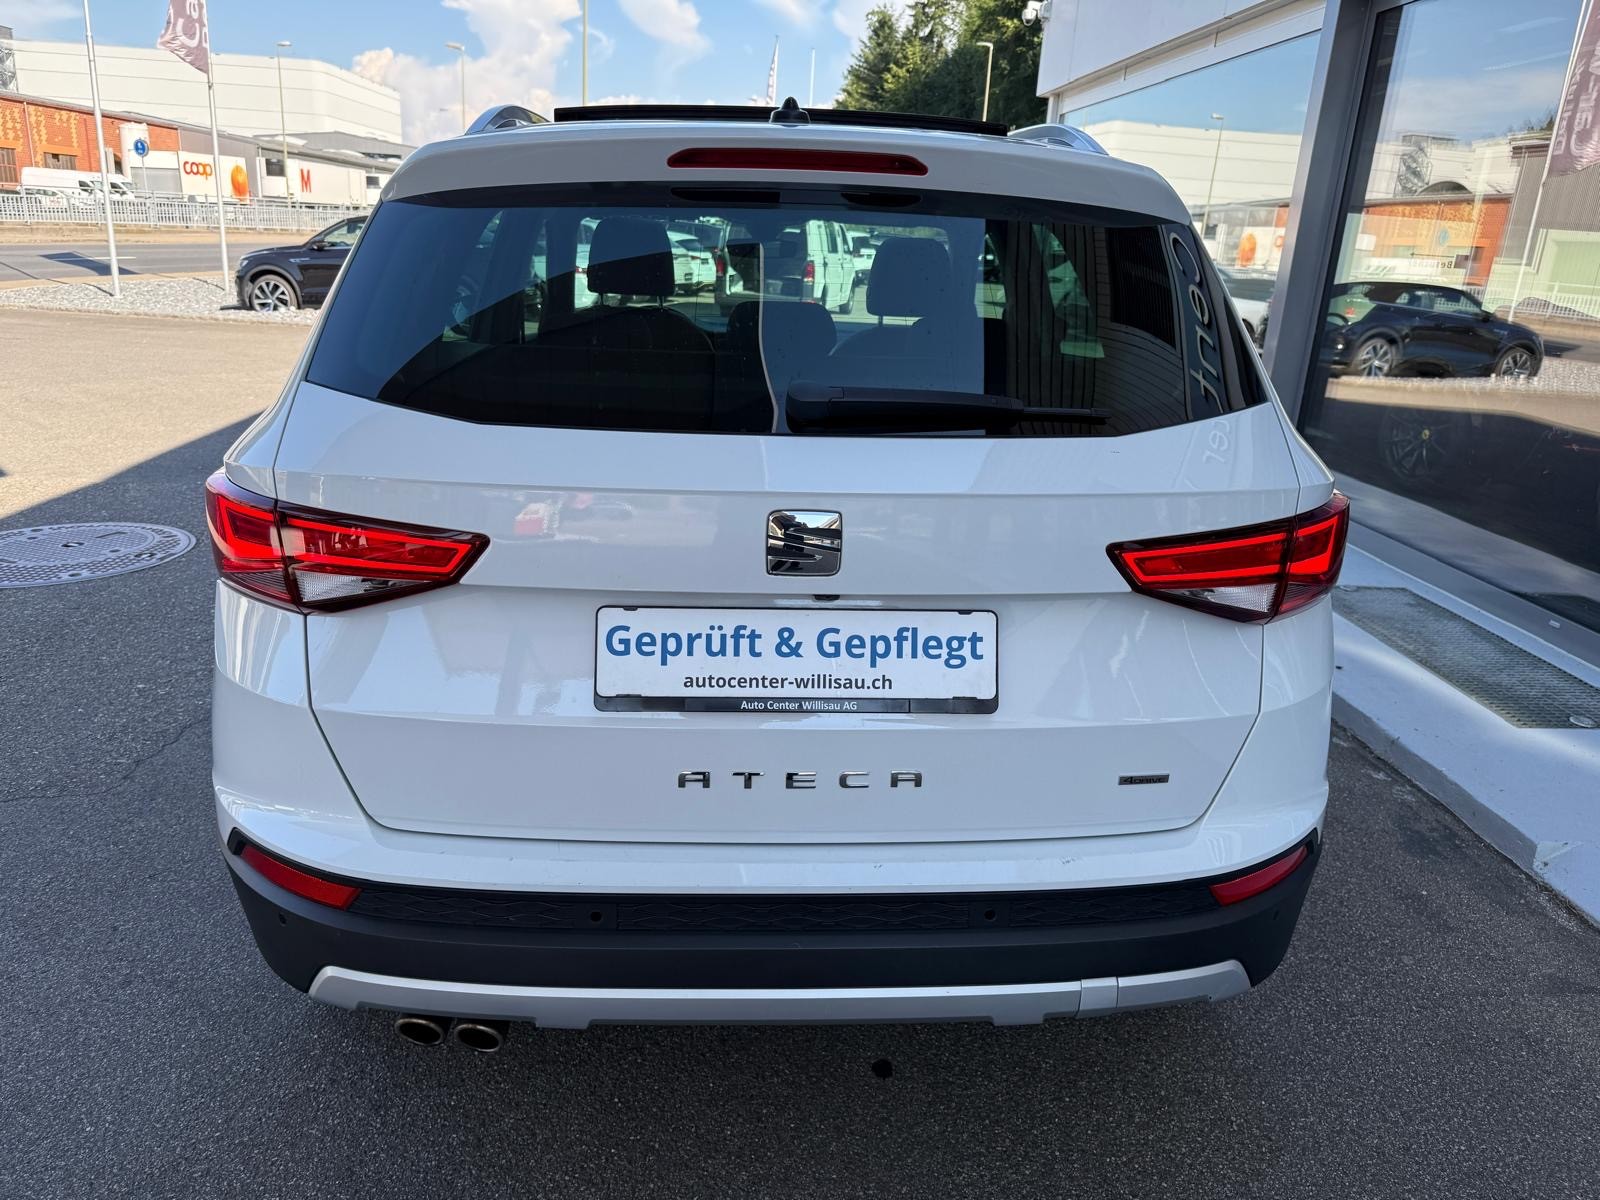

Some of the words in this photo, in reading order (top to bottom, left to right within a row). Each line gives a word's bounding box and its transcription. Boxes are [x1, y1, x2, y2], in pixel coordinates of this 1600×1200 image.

[183, 160, 213, 181] coop
[300, 168, 312, 193] M
[605, 624, 763, 669] Geprüft
[774, 626, 804, 659] &
[815, 626, 984, 670] Gepflegt
[683, 673, 893, 691] autocenter-willisau.ch
[740, 700, 765, 711] Auto
[766, 700, 799, 711] Center
[801, 700, 842, 711] Willisau
[843, 701, 858, 711] AG
[677, 770, 923, 789] ATECA
